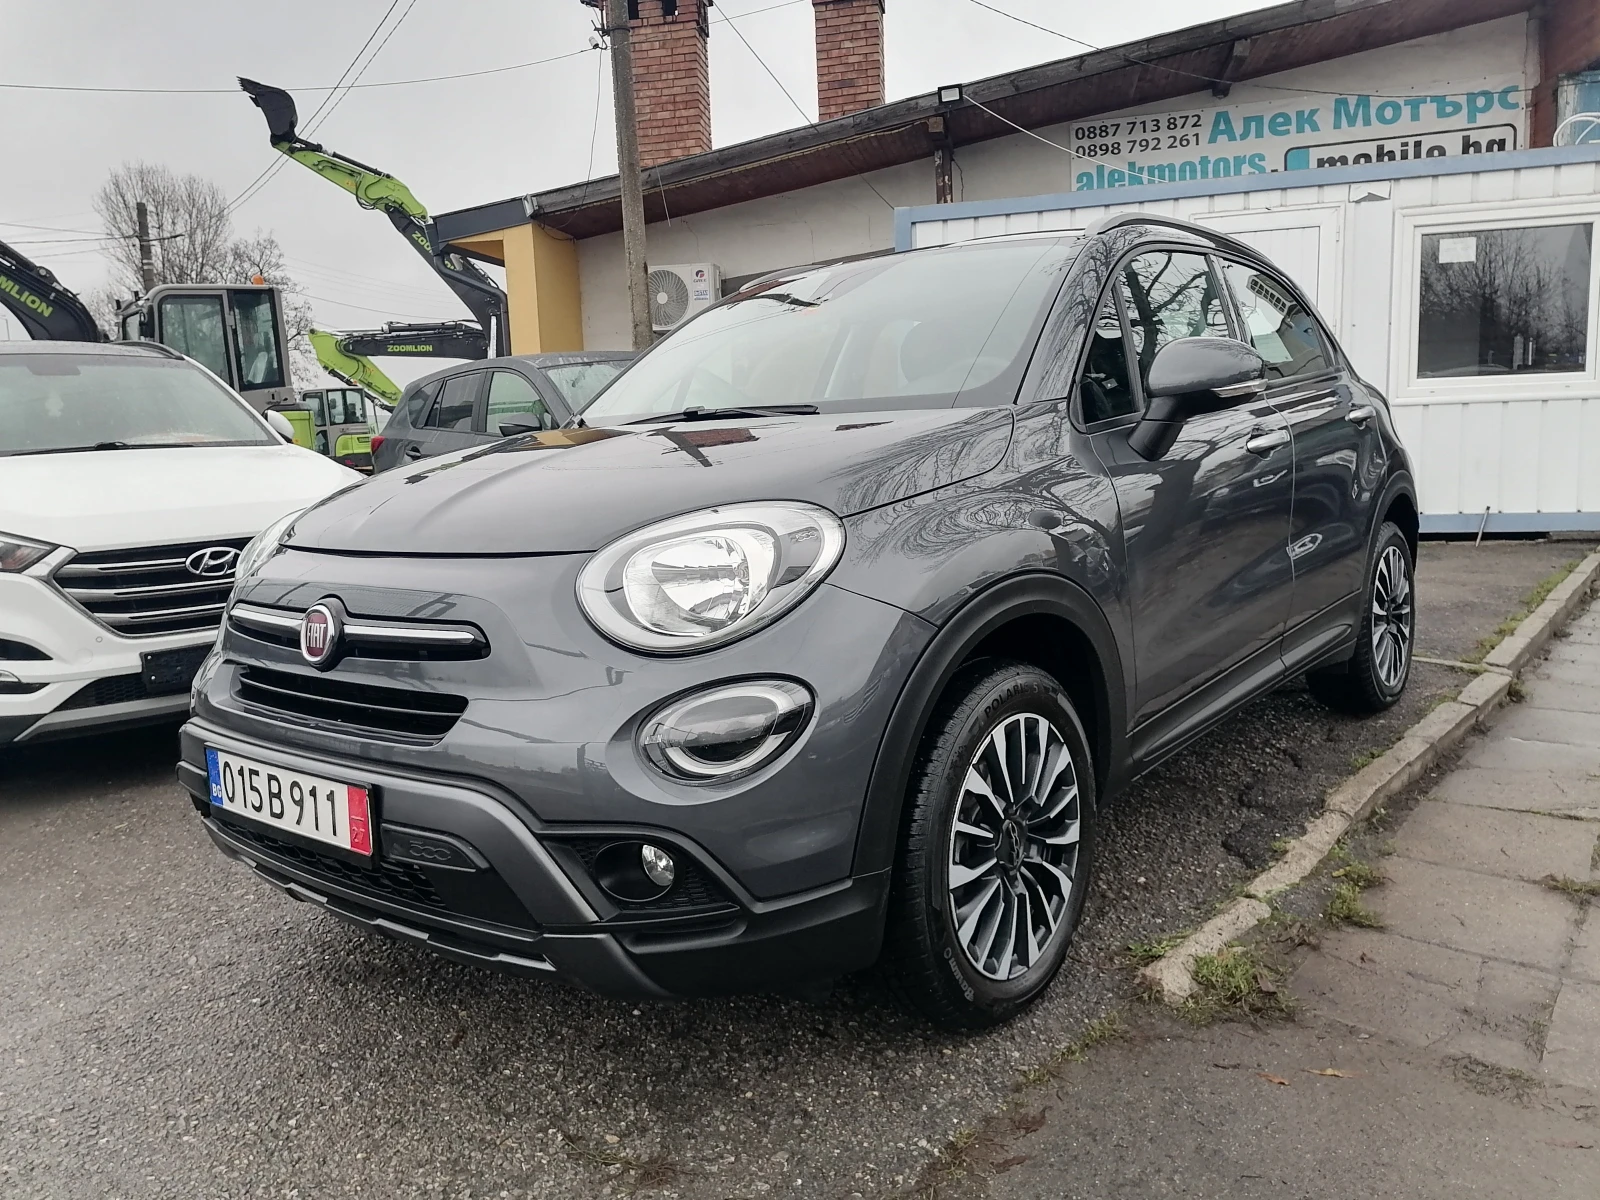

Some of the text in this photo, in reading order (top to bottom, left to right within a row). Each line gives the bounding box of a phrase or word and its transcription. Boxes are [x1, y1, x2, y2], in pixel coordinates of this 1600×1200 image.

[1075, 113, 1202, 141] 0887 713 872
[1207, 84, 1520, 144] Алек Мотърс
[1075, 132, 1201, 159] 0898 792 261
[387, 344, 433, 352] ZOOMLION
[306, 622, 327, 649] FIAT
[212, 783, 222, 798] BG
[222, 760, 337, 837] 015B911
